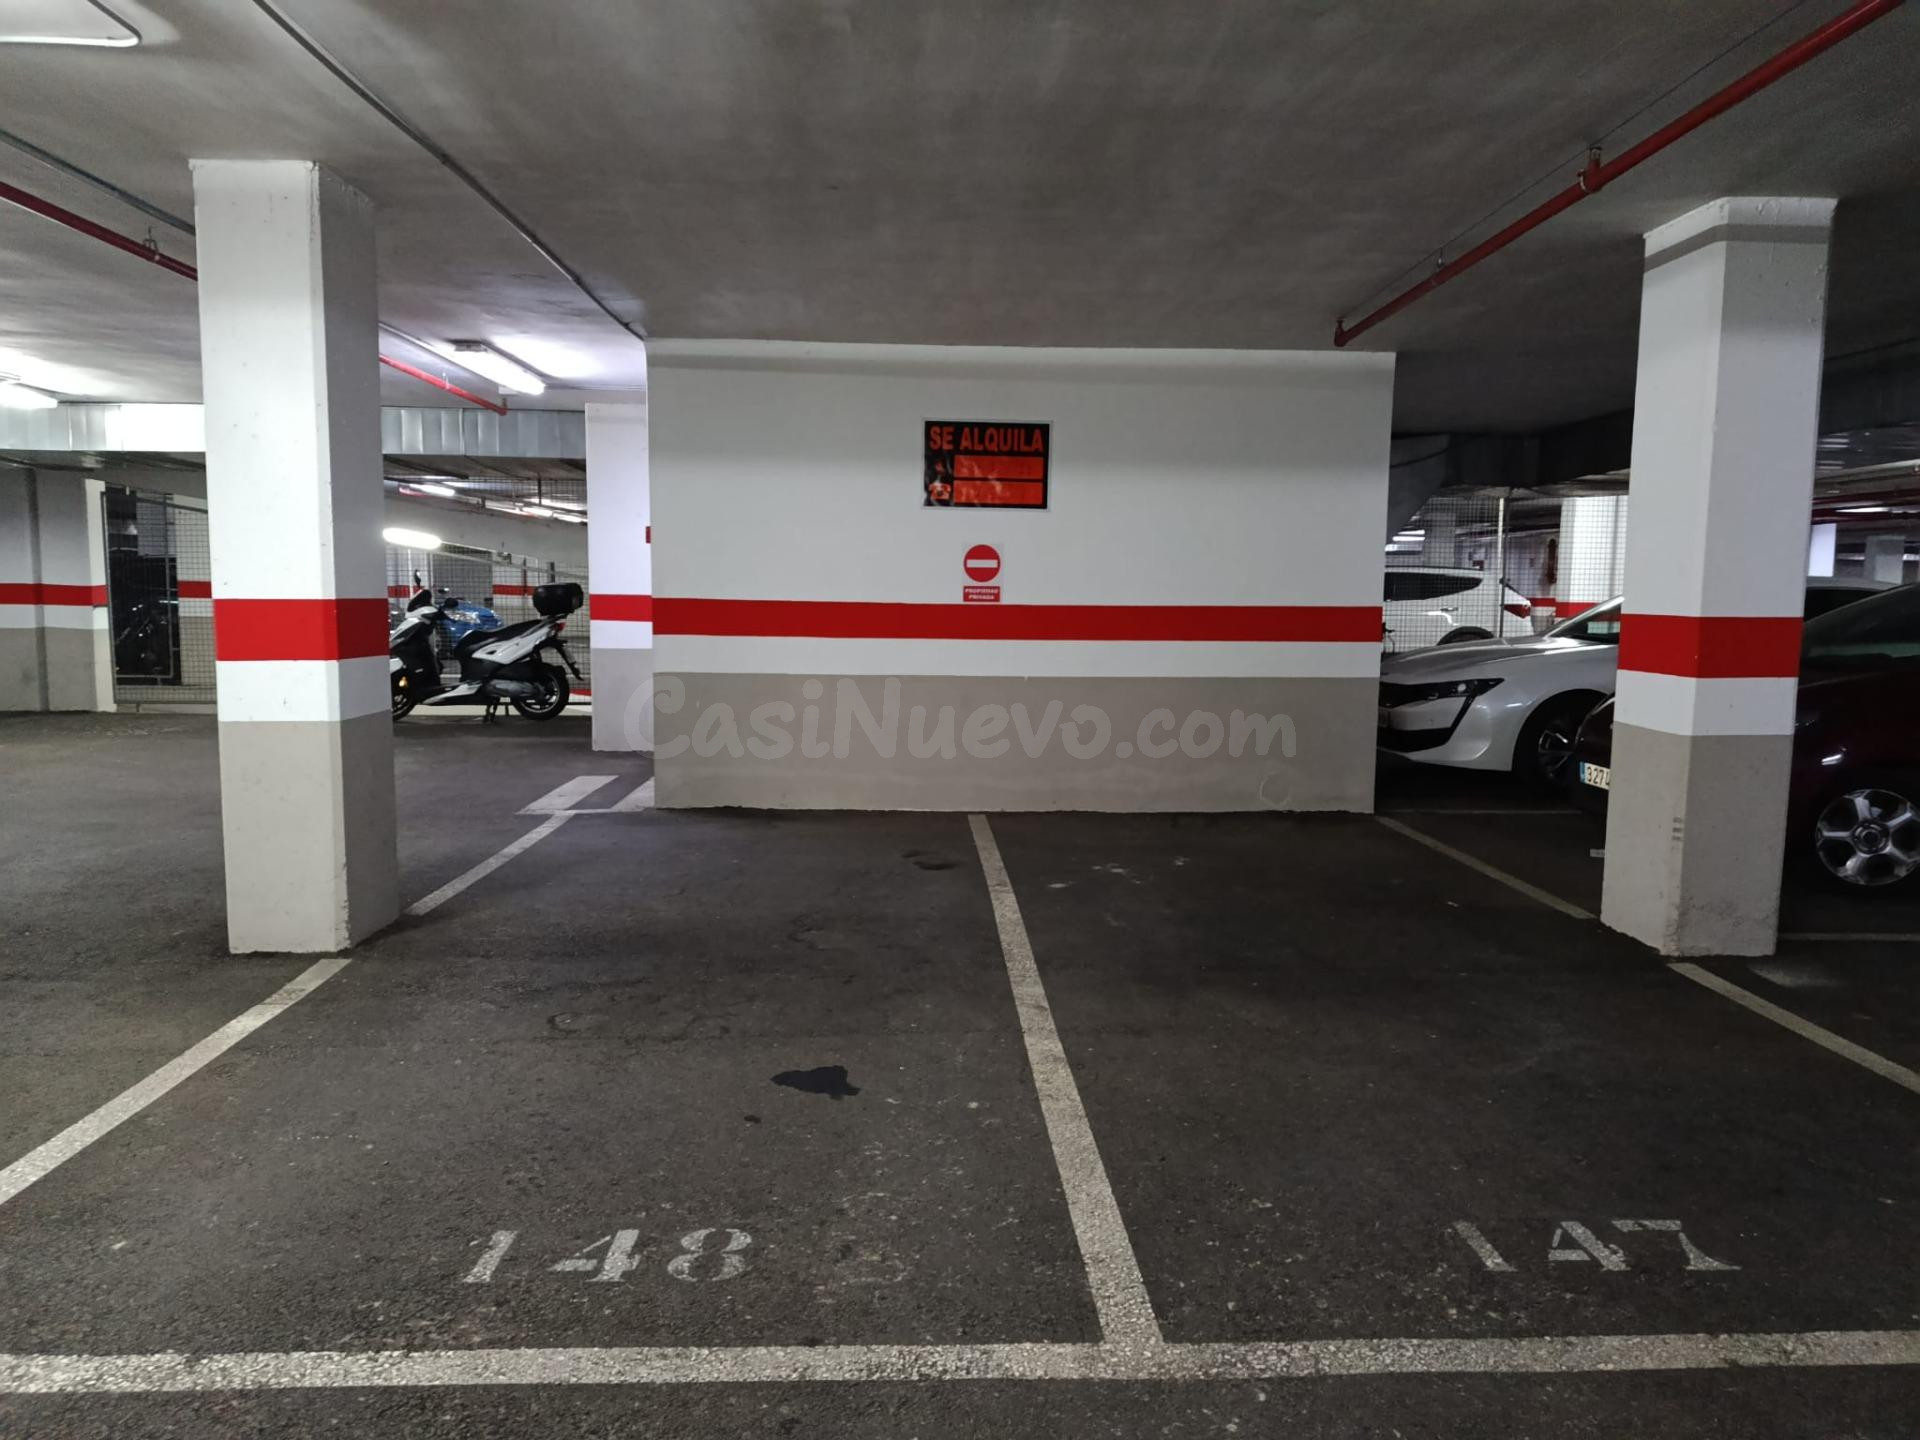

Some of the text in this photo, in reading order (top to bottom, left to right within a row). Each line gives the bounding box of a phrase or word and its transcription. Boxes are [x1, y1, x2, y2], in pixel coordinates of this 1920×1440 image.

[929, 426, 1043, 452] SE ALQUILA
[462, 1229, 752, 1283] 148
[1453, 1219, 1742, 1272] 147
